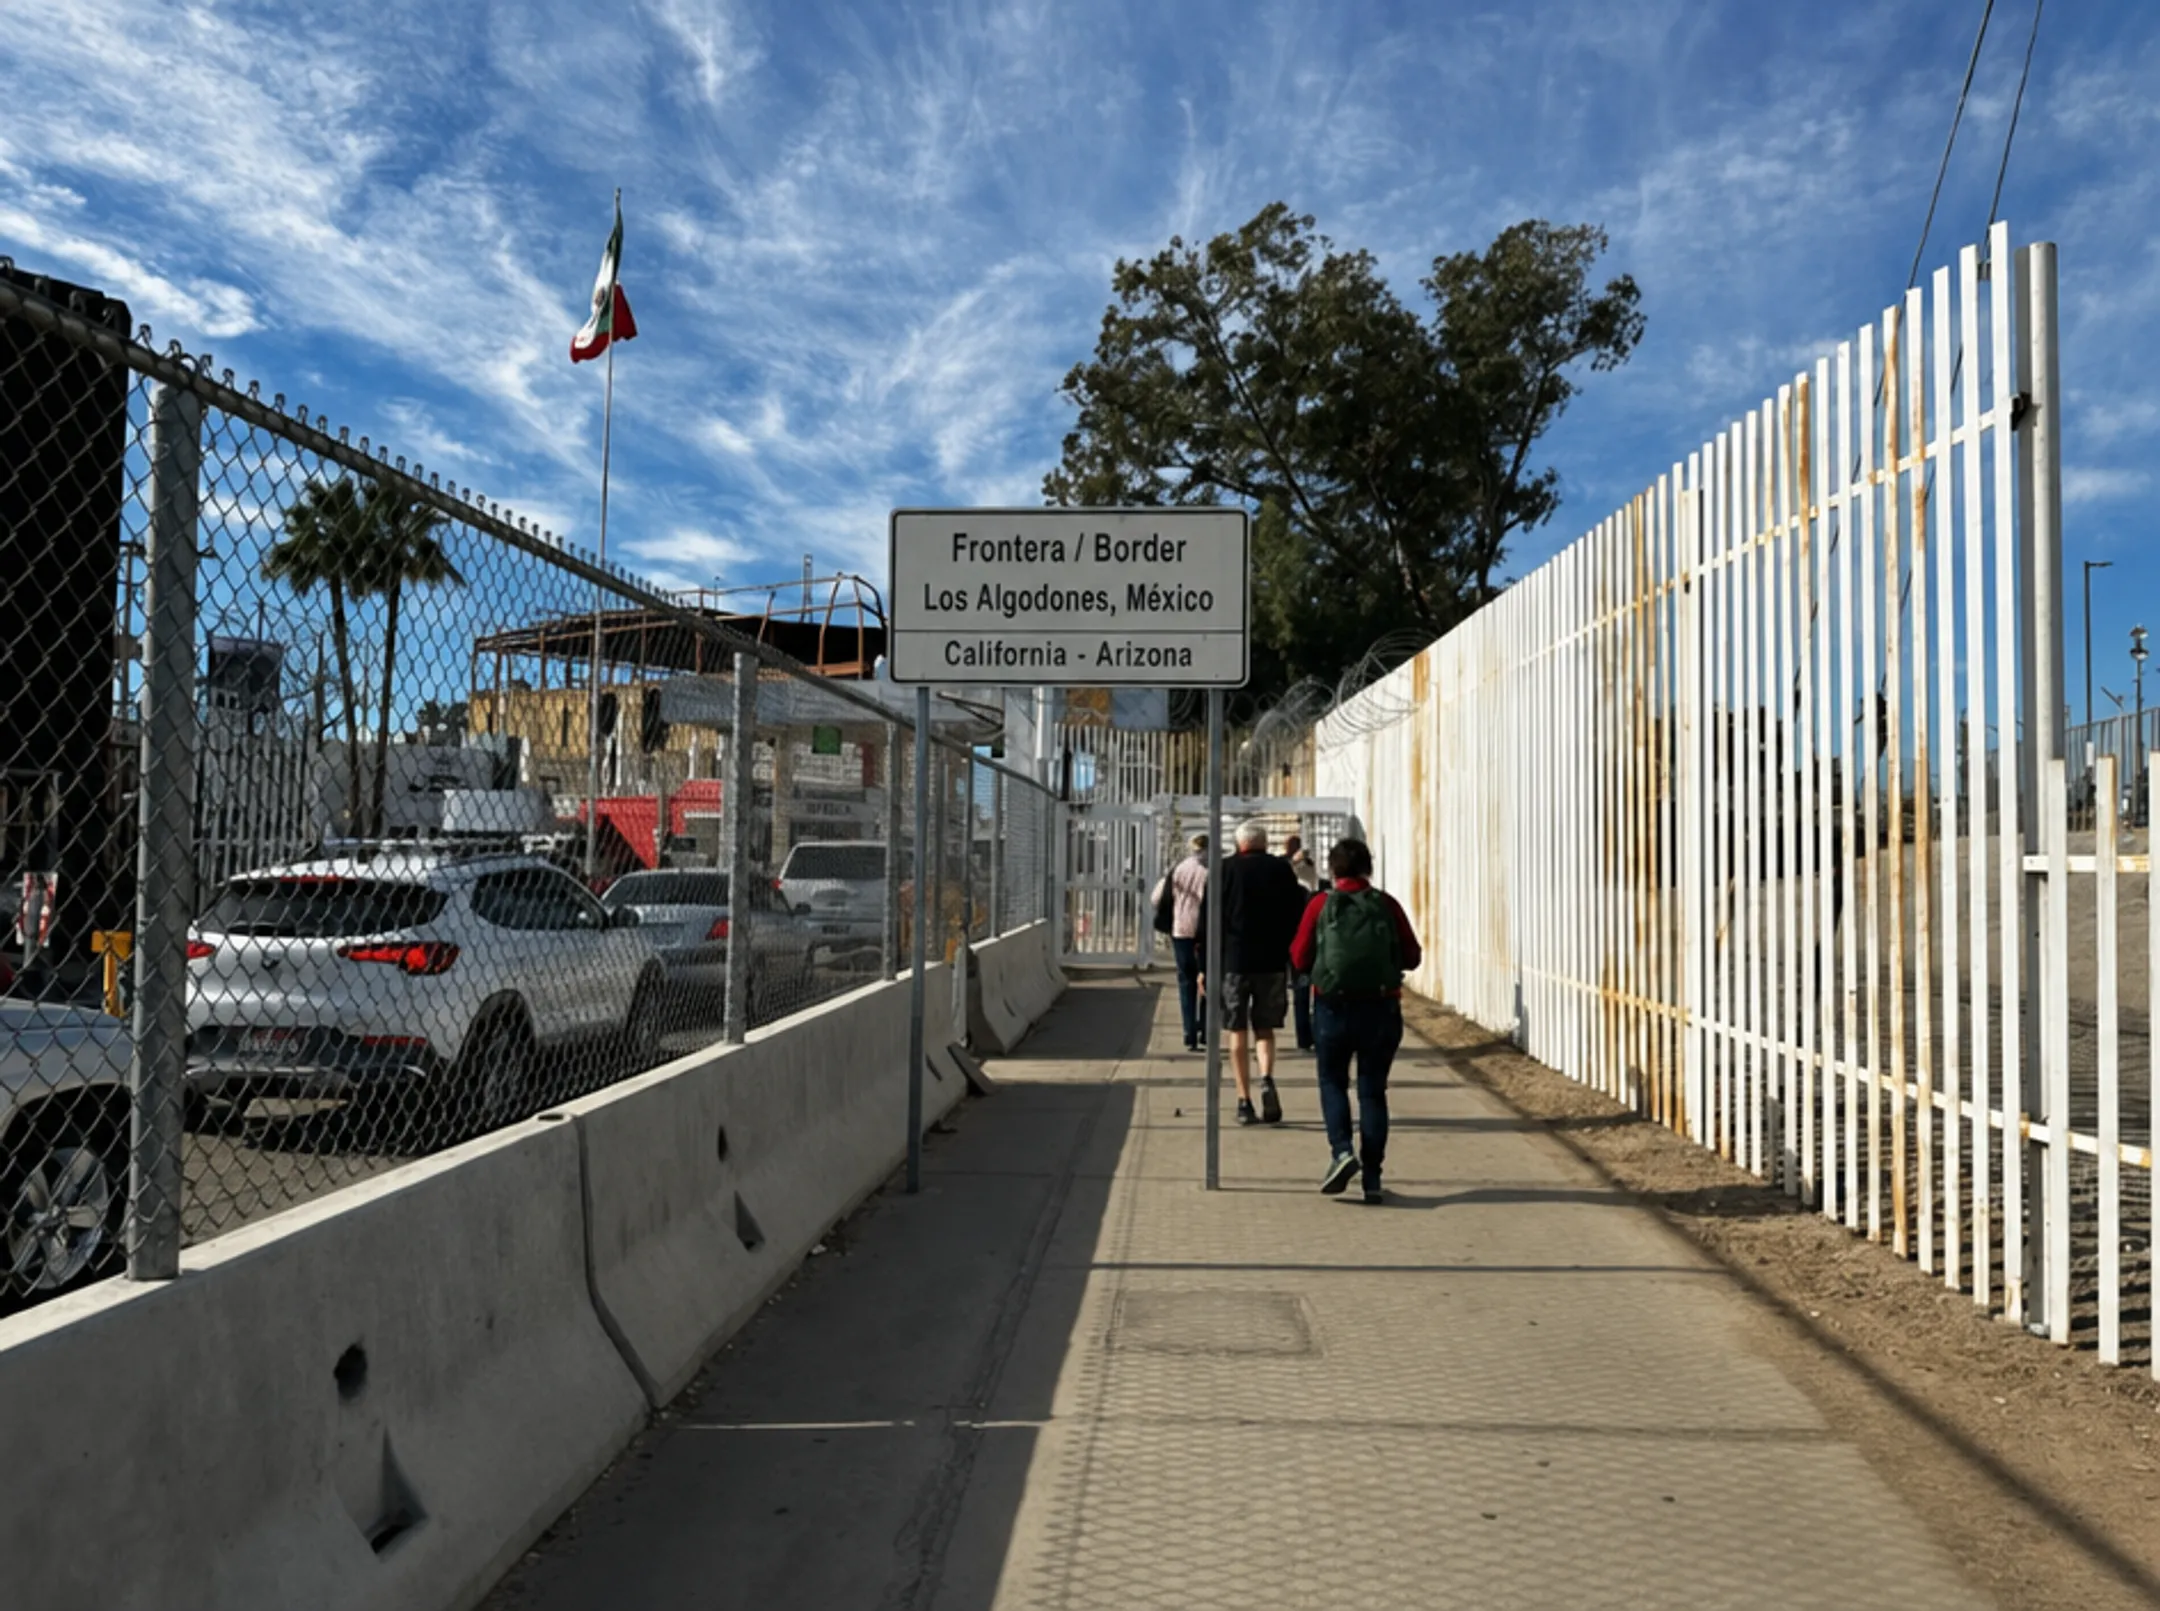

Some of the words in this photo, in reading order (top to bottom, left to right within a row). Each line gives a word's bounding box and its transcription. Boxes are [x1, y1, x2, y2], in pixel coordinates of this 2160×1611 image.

[952, 532, 1066, 563] Frontera
[1074, 532, 1085, 562] /
[1094, 532, 1188, 563] Border
[924, 583, 969, 612] Los
[976, 583, 1117, 619] Algodones,
[1126, 582, 1214, 613] México
[944, 639, 1067, 667] California
[1095, 640, 1192, 668] Arizona
